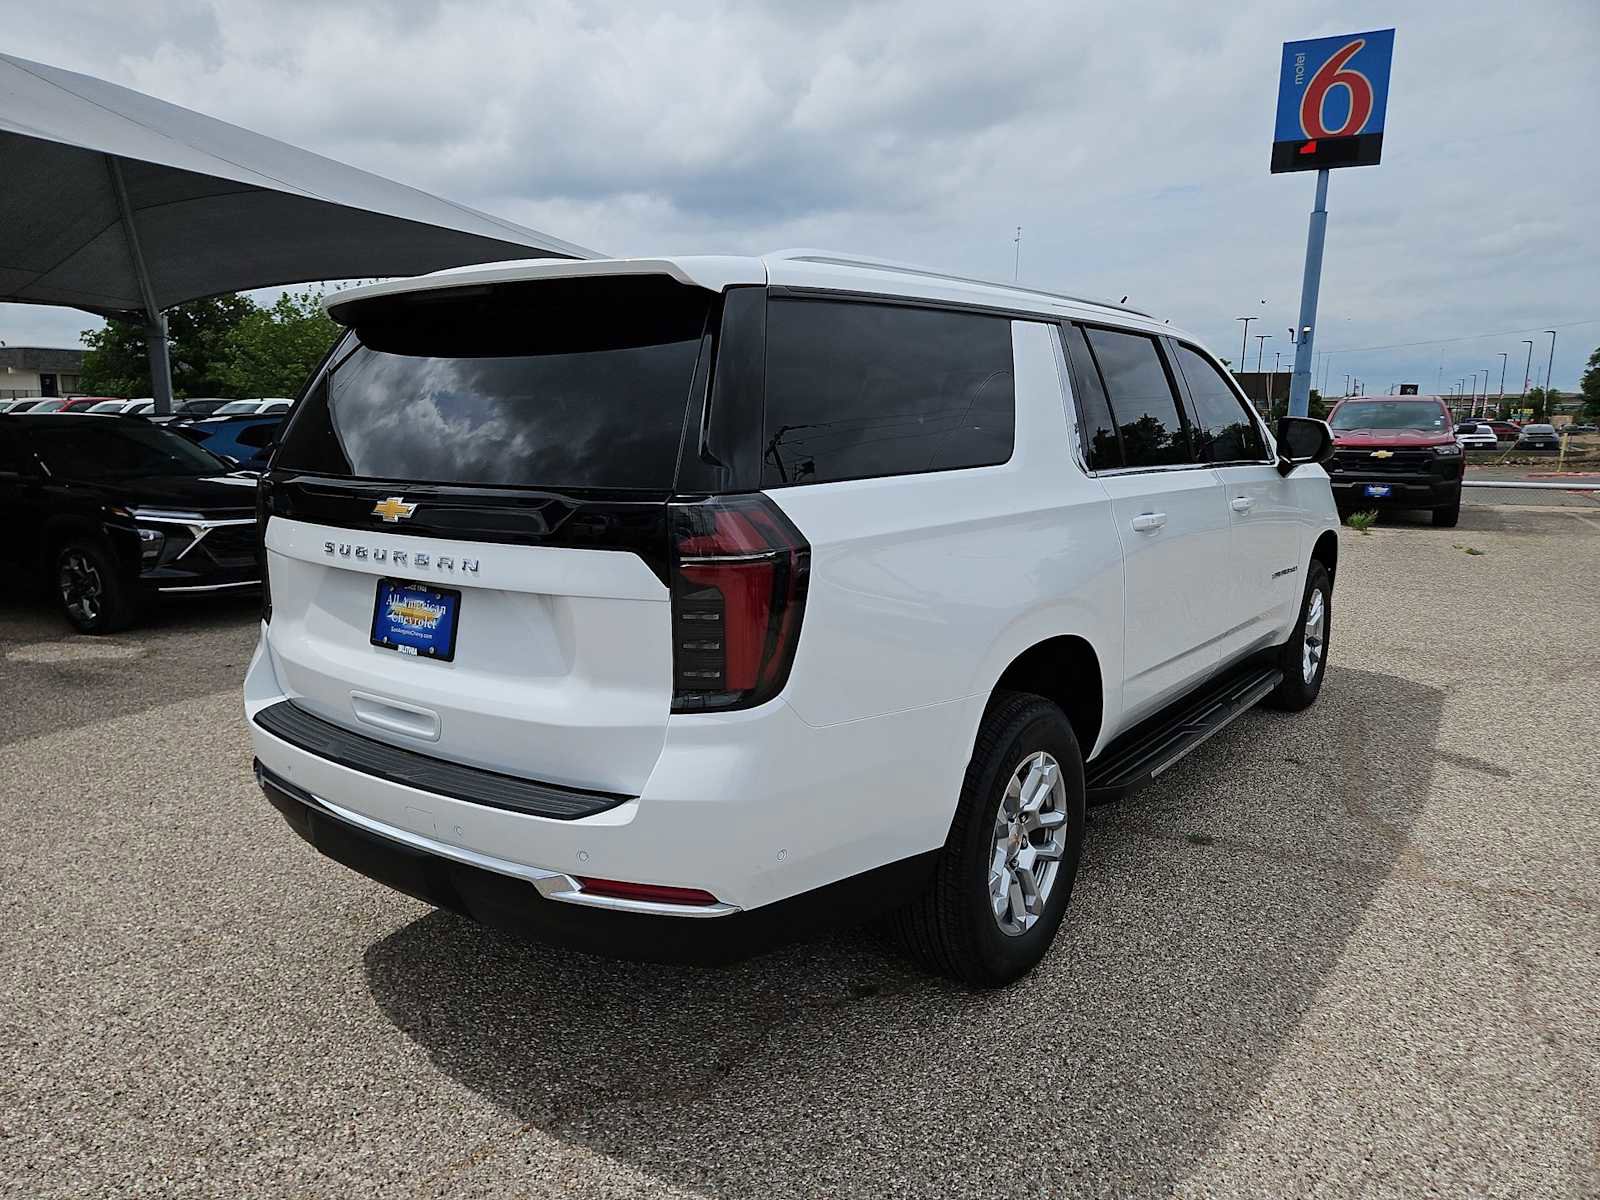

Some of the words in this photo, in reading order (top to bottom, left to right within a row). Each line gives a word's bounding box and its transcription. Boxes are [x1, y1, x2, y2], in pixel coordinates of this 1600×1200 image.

[1295, 53, 1305, 84] motel
[1299, 38, 1374, 139] 6
[324, 541, 479, 573] SUBURBAN
[391, 610, 437, 629] Chevrolet
